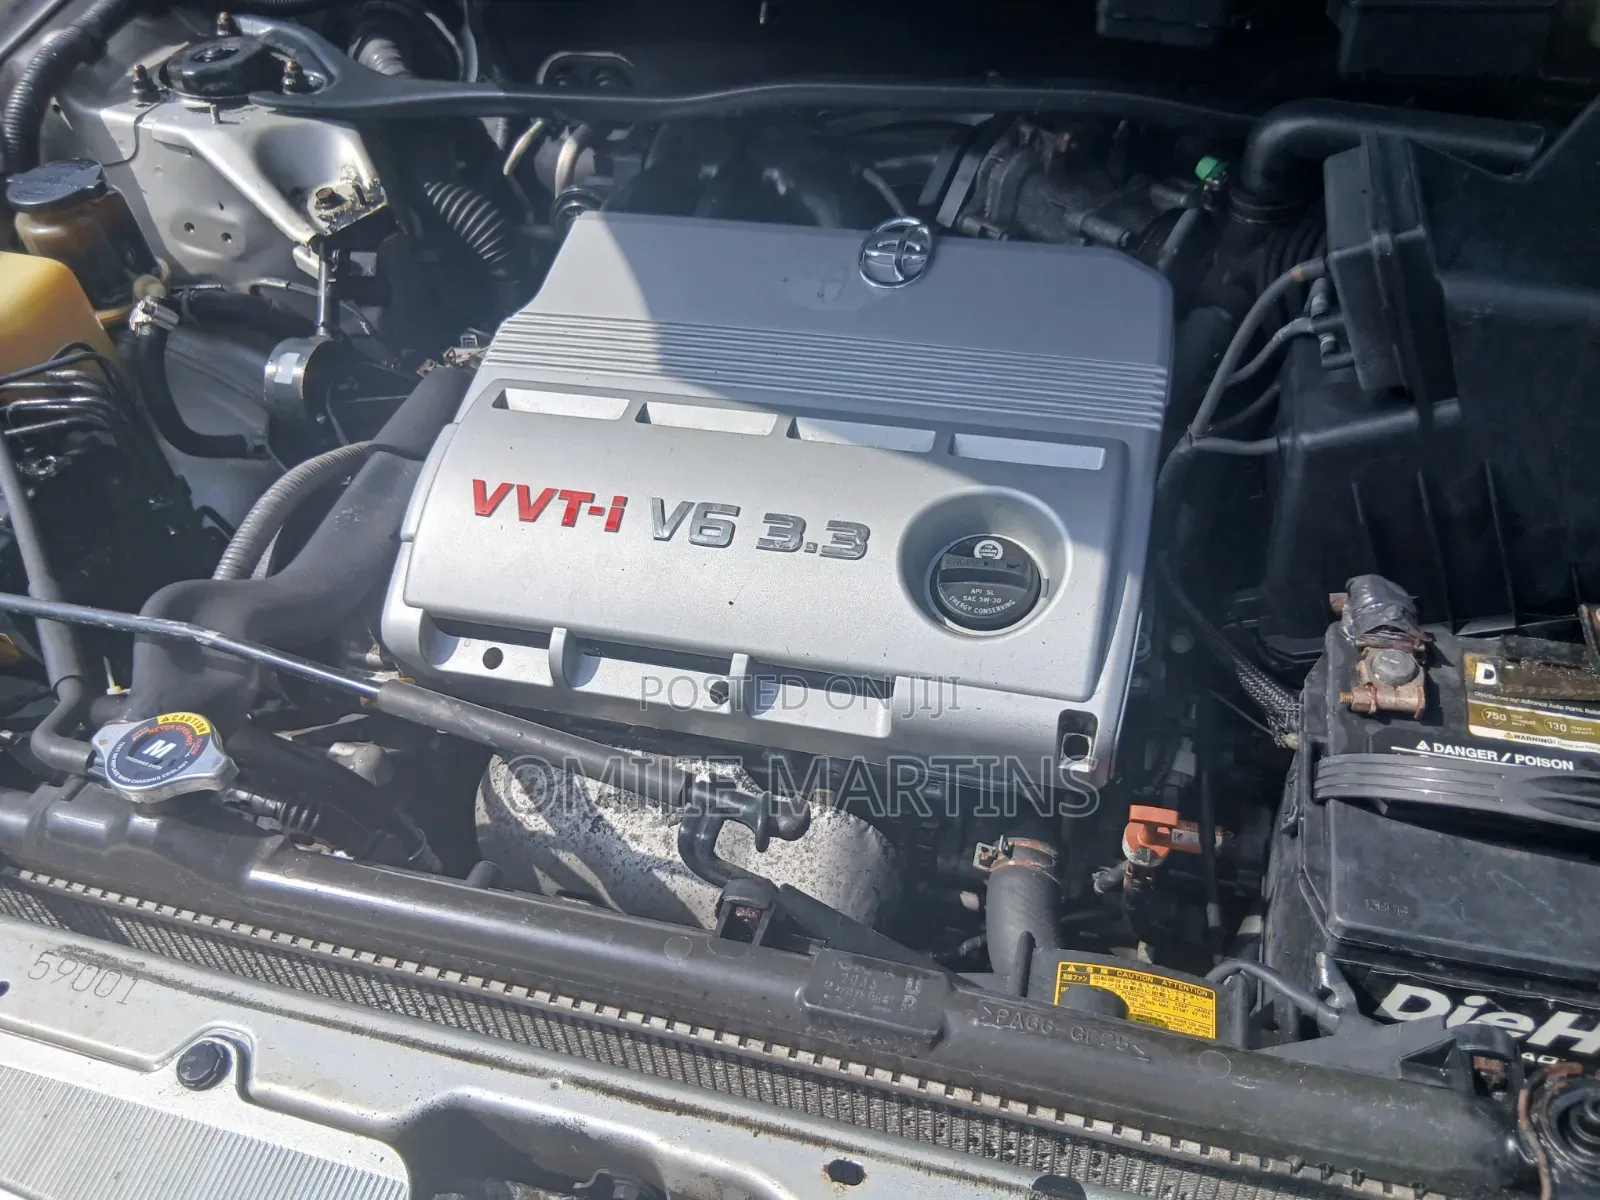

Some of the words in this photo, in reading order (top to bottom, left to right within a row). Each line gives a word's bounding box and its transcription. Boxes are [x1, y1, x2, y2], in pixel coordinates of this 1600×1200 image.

[472, 478, 629, 534] VVT-i
[650, 496, 742, 549] V6
[755, 512, 871, 561] 3.3
[949, 595, 973, 612] ENERGY
[974, 599, 1016, 614] CONSERVING
[979, 596, 1002, 604] 5W-30
[1520, 698, 1548, 708] Advance
[1549, 703, 1563, 711] Auto
[171, 714, 207, 734] CAUTION
[1485, 710, 1507, 721] 750
[148, 723, 176, 736] NEVER
[1547, 721, 1568, 733] 130
[142, 739, 177, 759] M
[1433, 742, 1498, 762] DANGER
[1515, 752, 1575, 771] POISON
[161, 760, 188, 778] COOLANT
[27, 951, 140, 1006] 59001
[1116, 970, 1154, 982] CAUTION
[1162, 979, 1208, 997] ATTENTION
